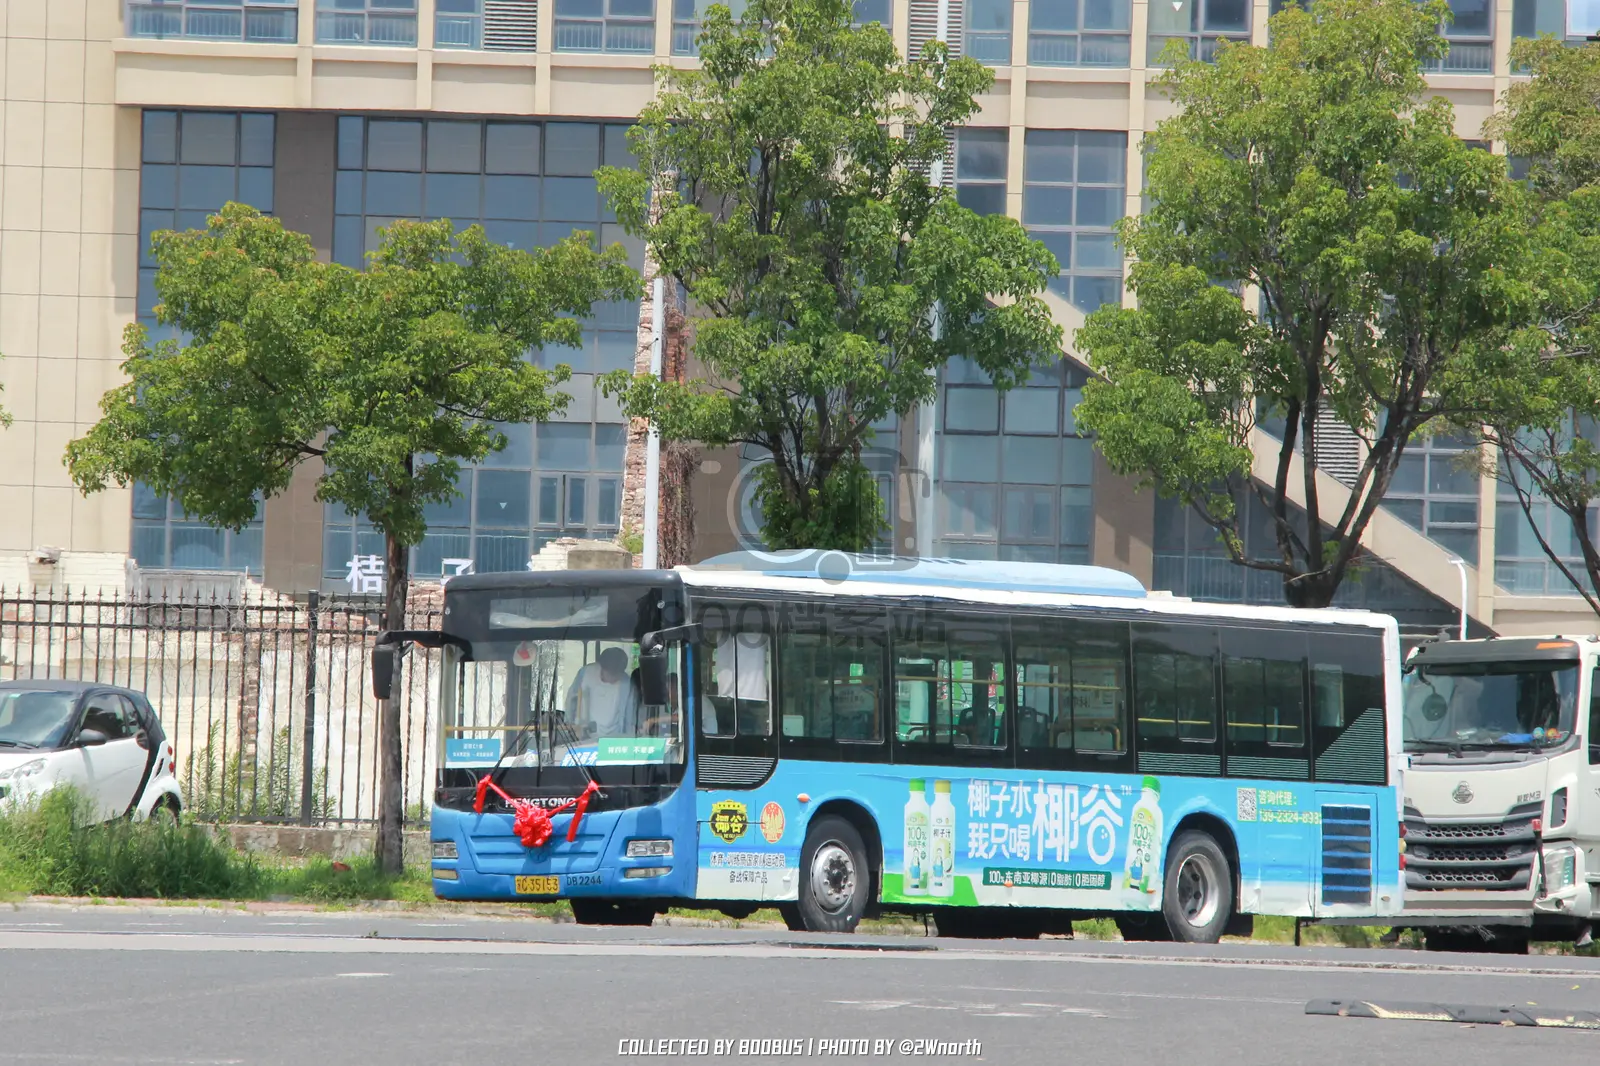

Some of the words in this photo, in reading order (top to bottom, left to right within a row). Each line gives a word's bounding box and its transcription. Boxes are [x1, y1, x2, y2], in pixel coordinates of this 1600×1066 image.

[968, 779, 1032, 818] 椰子水
[1032, 778, 1123, 865] 椰谷
[968, 823, 1031, 861] 我只喝
